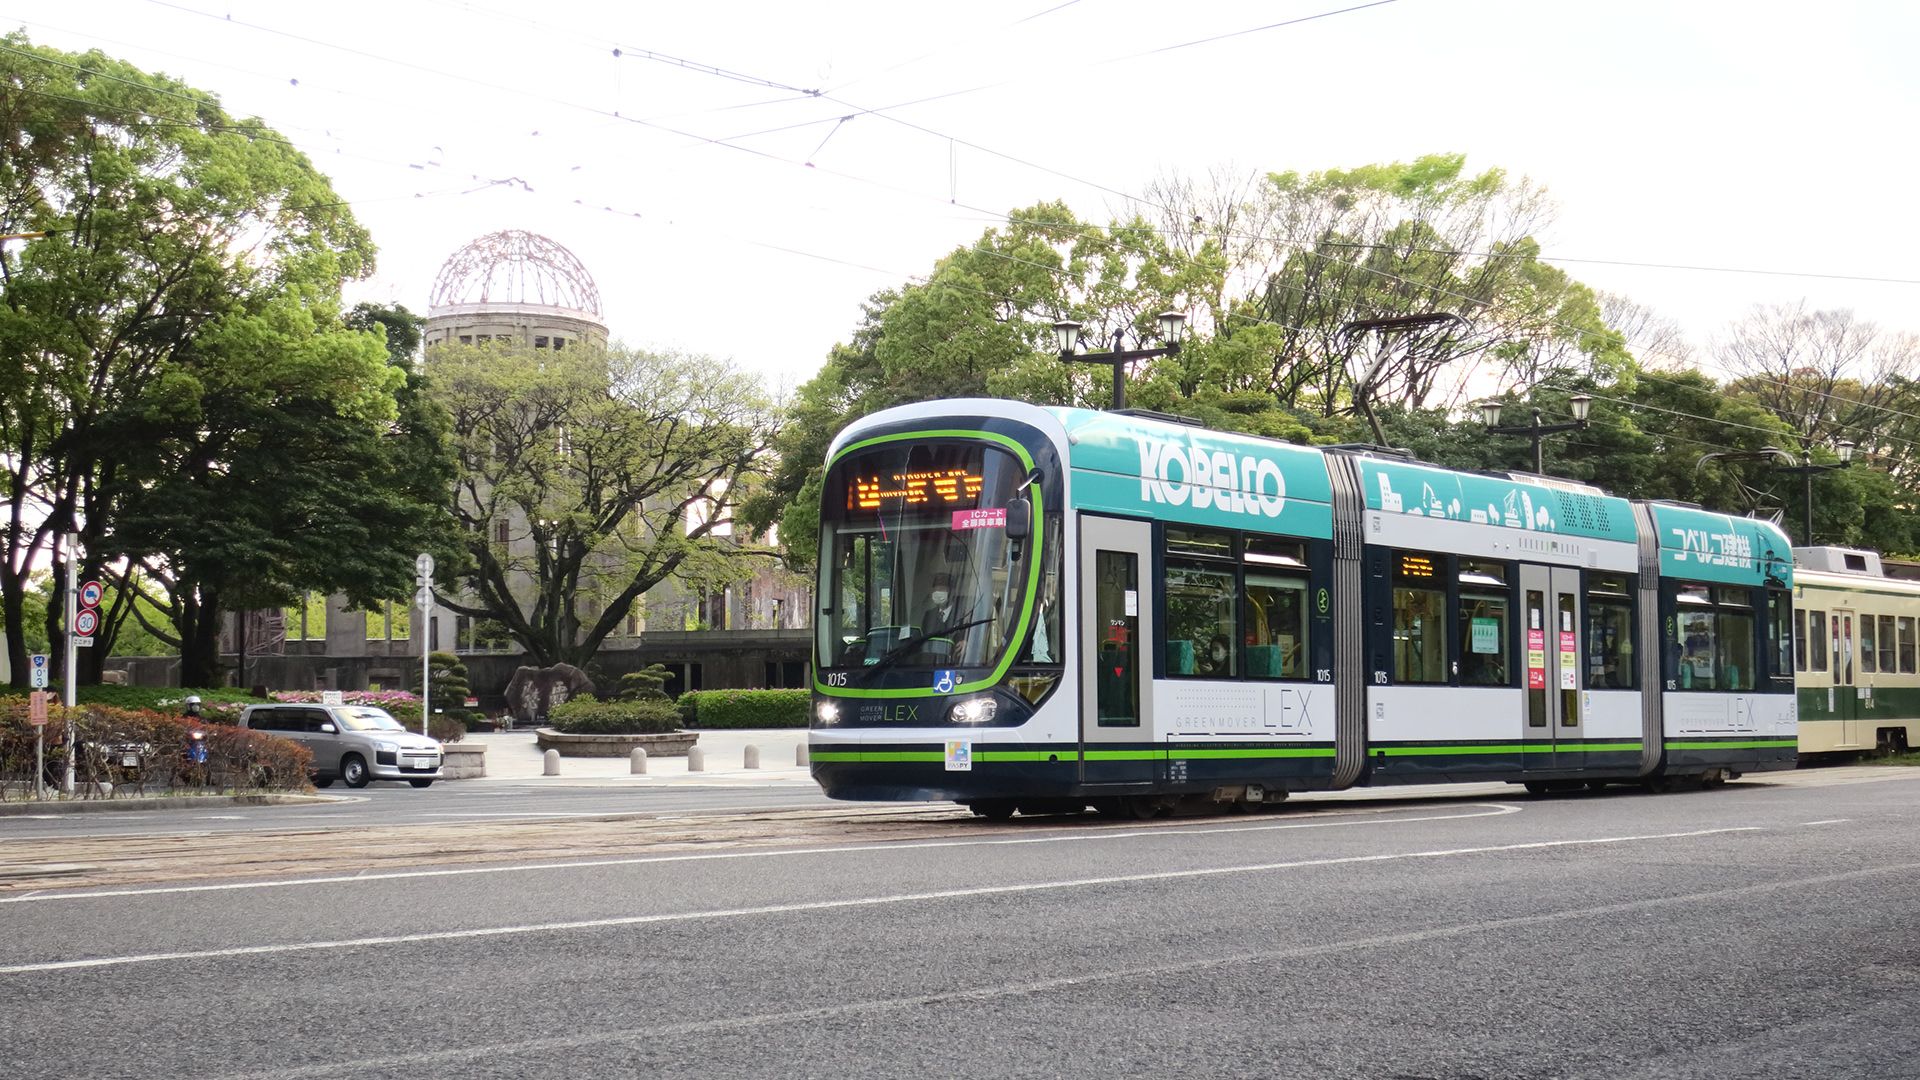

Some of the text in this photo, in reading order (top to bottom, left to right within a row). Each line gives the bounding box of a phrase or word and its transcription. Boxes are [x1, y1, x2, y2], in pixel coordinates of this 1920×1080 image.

[1138, 440, 1286, 518] KOBELCO
[971, 509, 1003, 518] ICカード
[961, 518, 1007, 528] 全扉降車車
[1672, 528, 1752, 568] コベルコ建機
[80, 617, 93, 628] 30
[827, 672, 848, 687] 1015
[1317, 669, 1331, 681] 1015
[1374, 671, 1388, 684] 1015
[884, 705, 919, 720] LEX
[1175, 689, 1313, 728] GREENMOVER LEX
[1727, 698, 1755, 727] LEX
